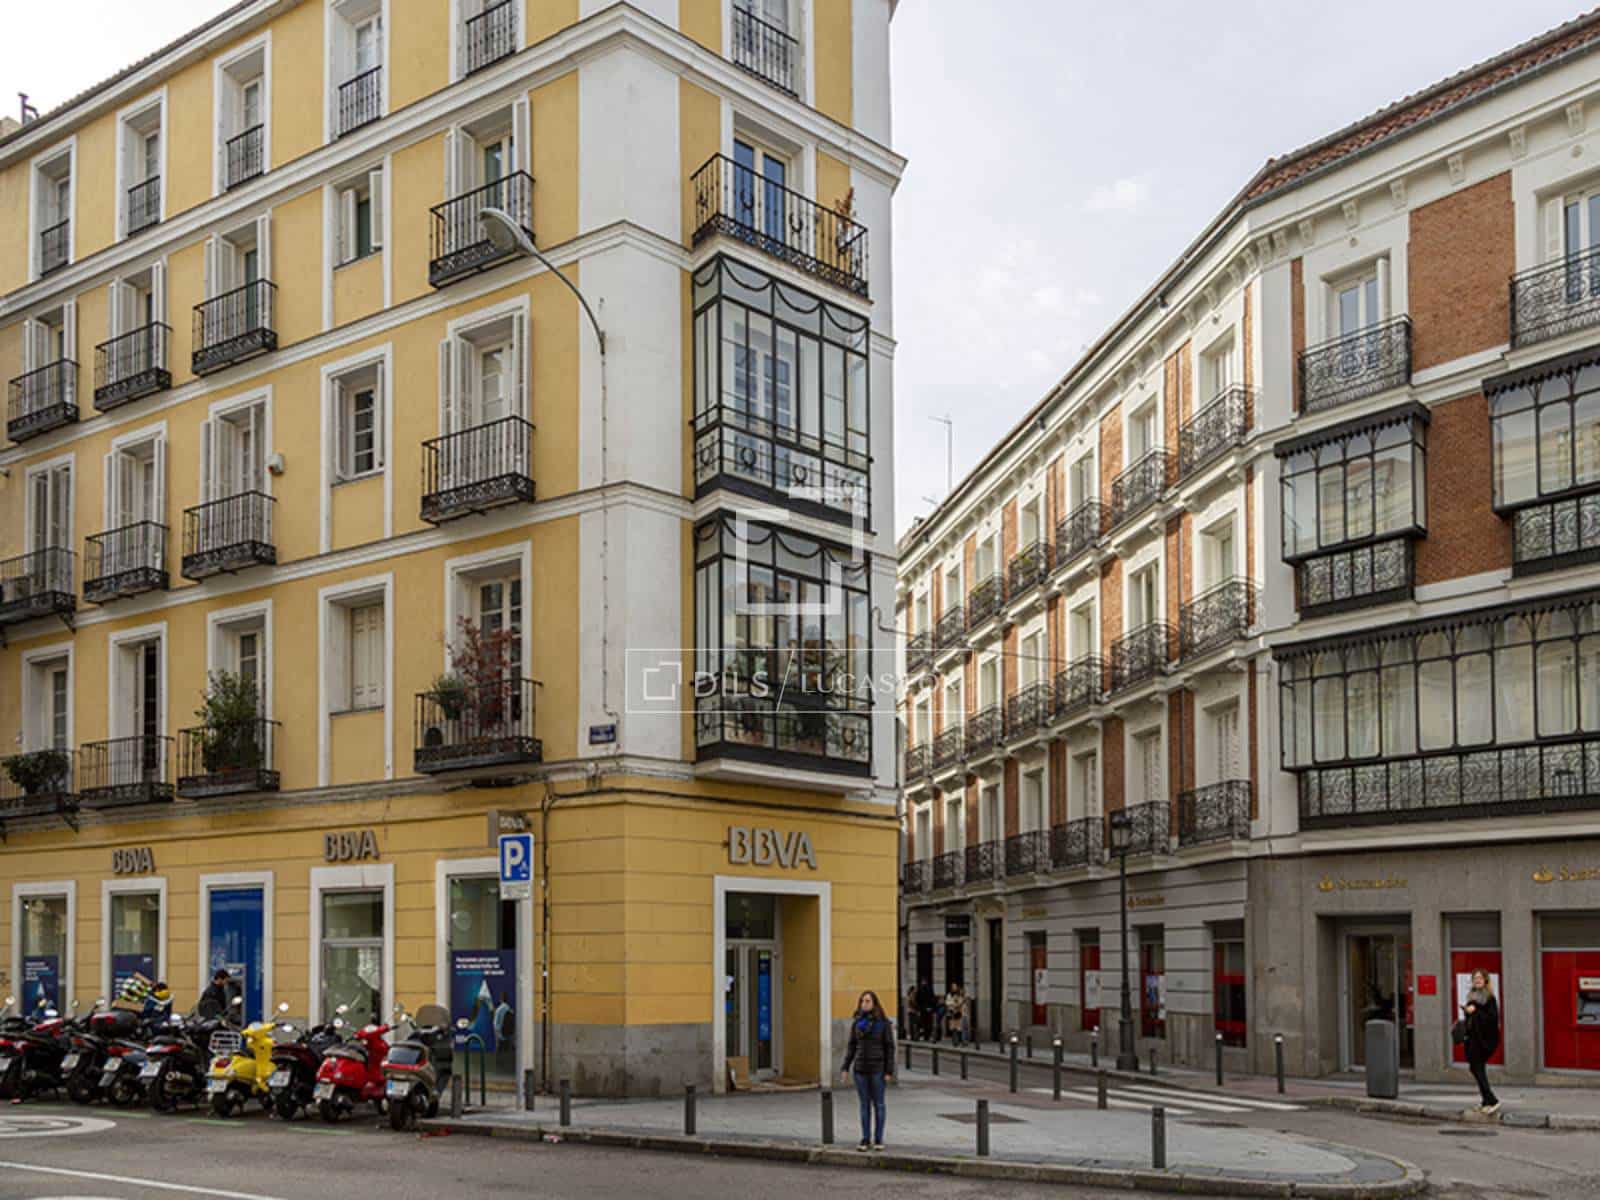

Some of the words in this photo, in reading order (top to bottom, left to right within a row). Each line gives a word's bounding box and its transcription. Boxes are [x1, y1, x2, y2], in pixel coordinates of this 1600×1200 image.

[112, 847, 154, 873] BBVA
[324, 829, 379, 861] BBVA
[504, 840, 524, 877] P
[727, 826, 817, 869] BBVA
